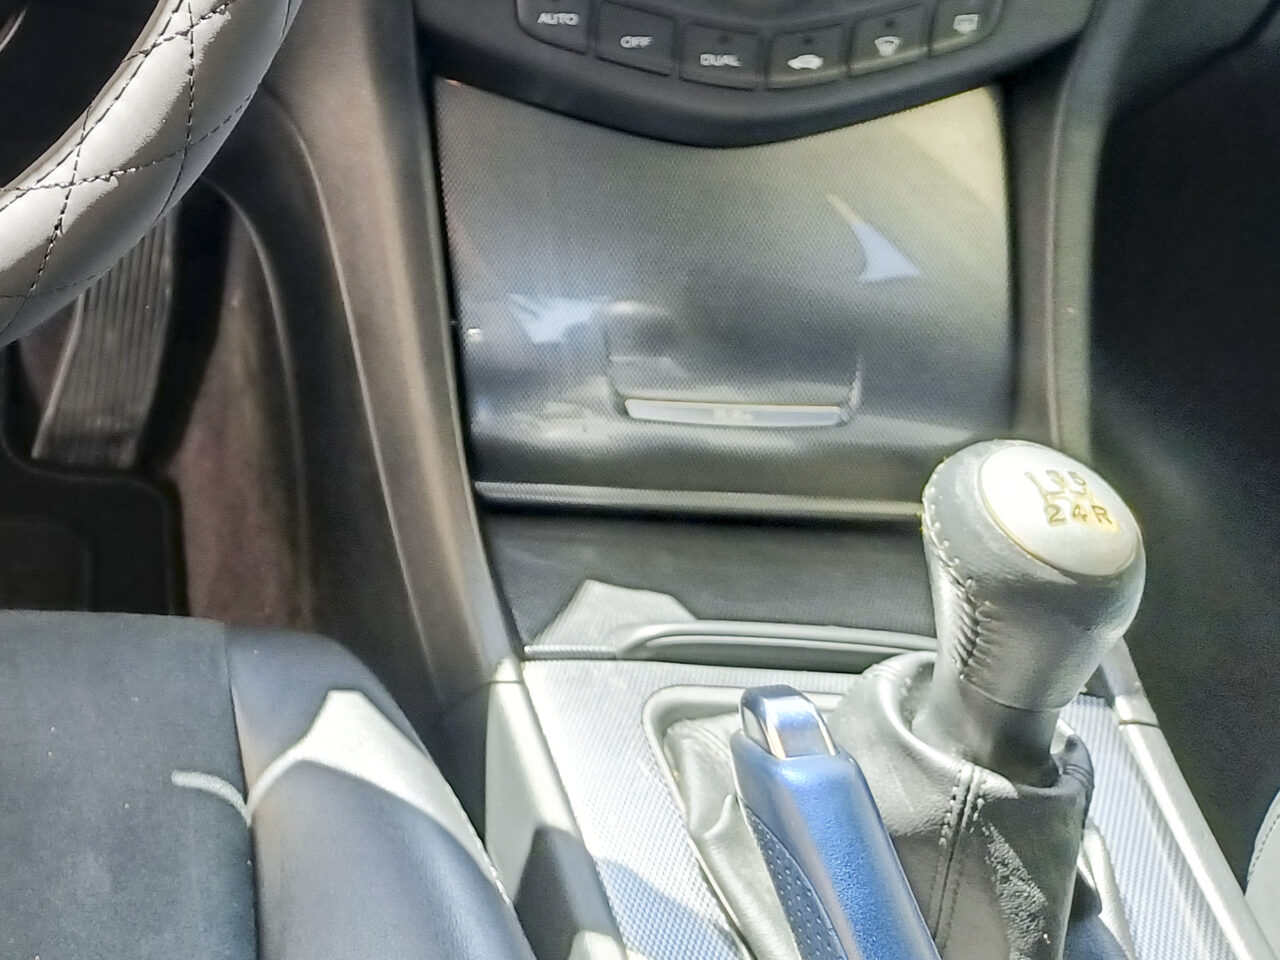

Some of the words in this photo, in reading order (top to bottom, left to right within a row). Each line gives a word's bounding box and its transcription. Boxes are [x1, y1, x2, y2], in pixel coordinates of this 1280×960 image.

[537, 12, 580, 26] AUTO
[620, 35, 653, 49] OFF
[700, 53, 741, 67] DUAL
[1046, 504, 1067, 523] 2
[1072, 504, 1087, 521] 4
[1091, 504, 1112, 525] R
